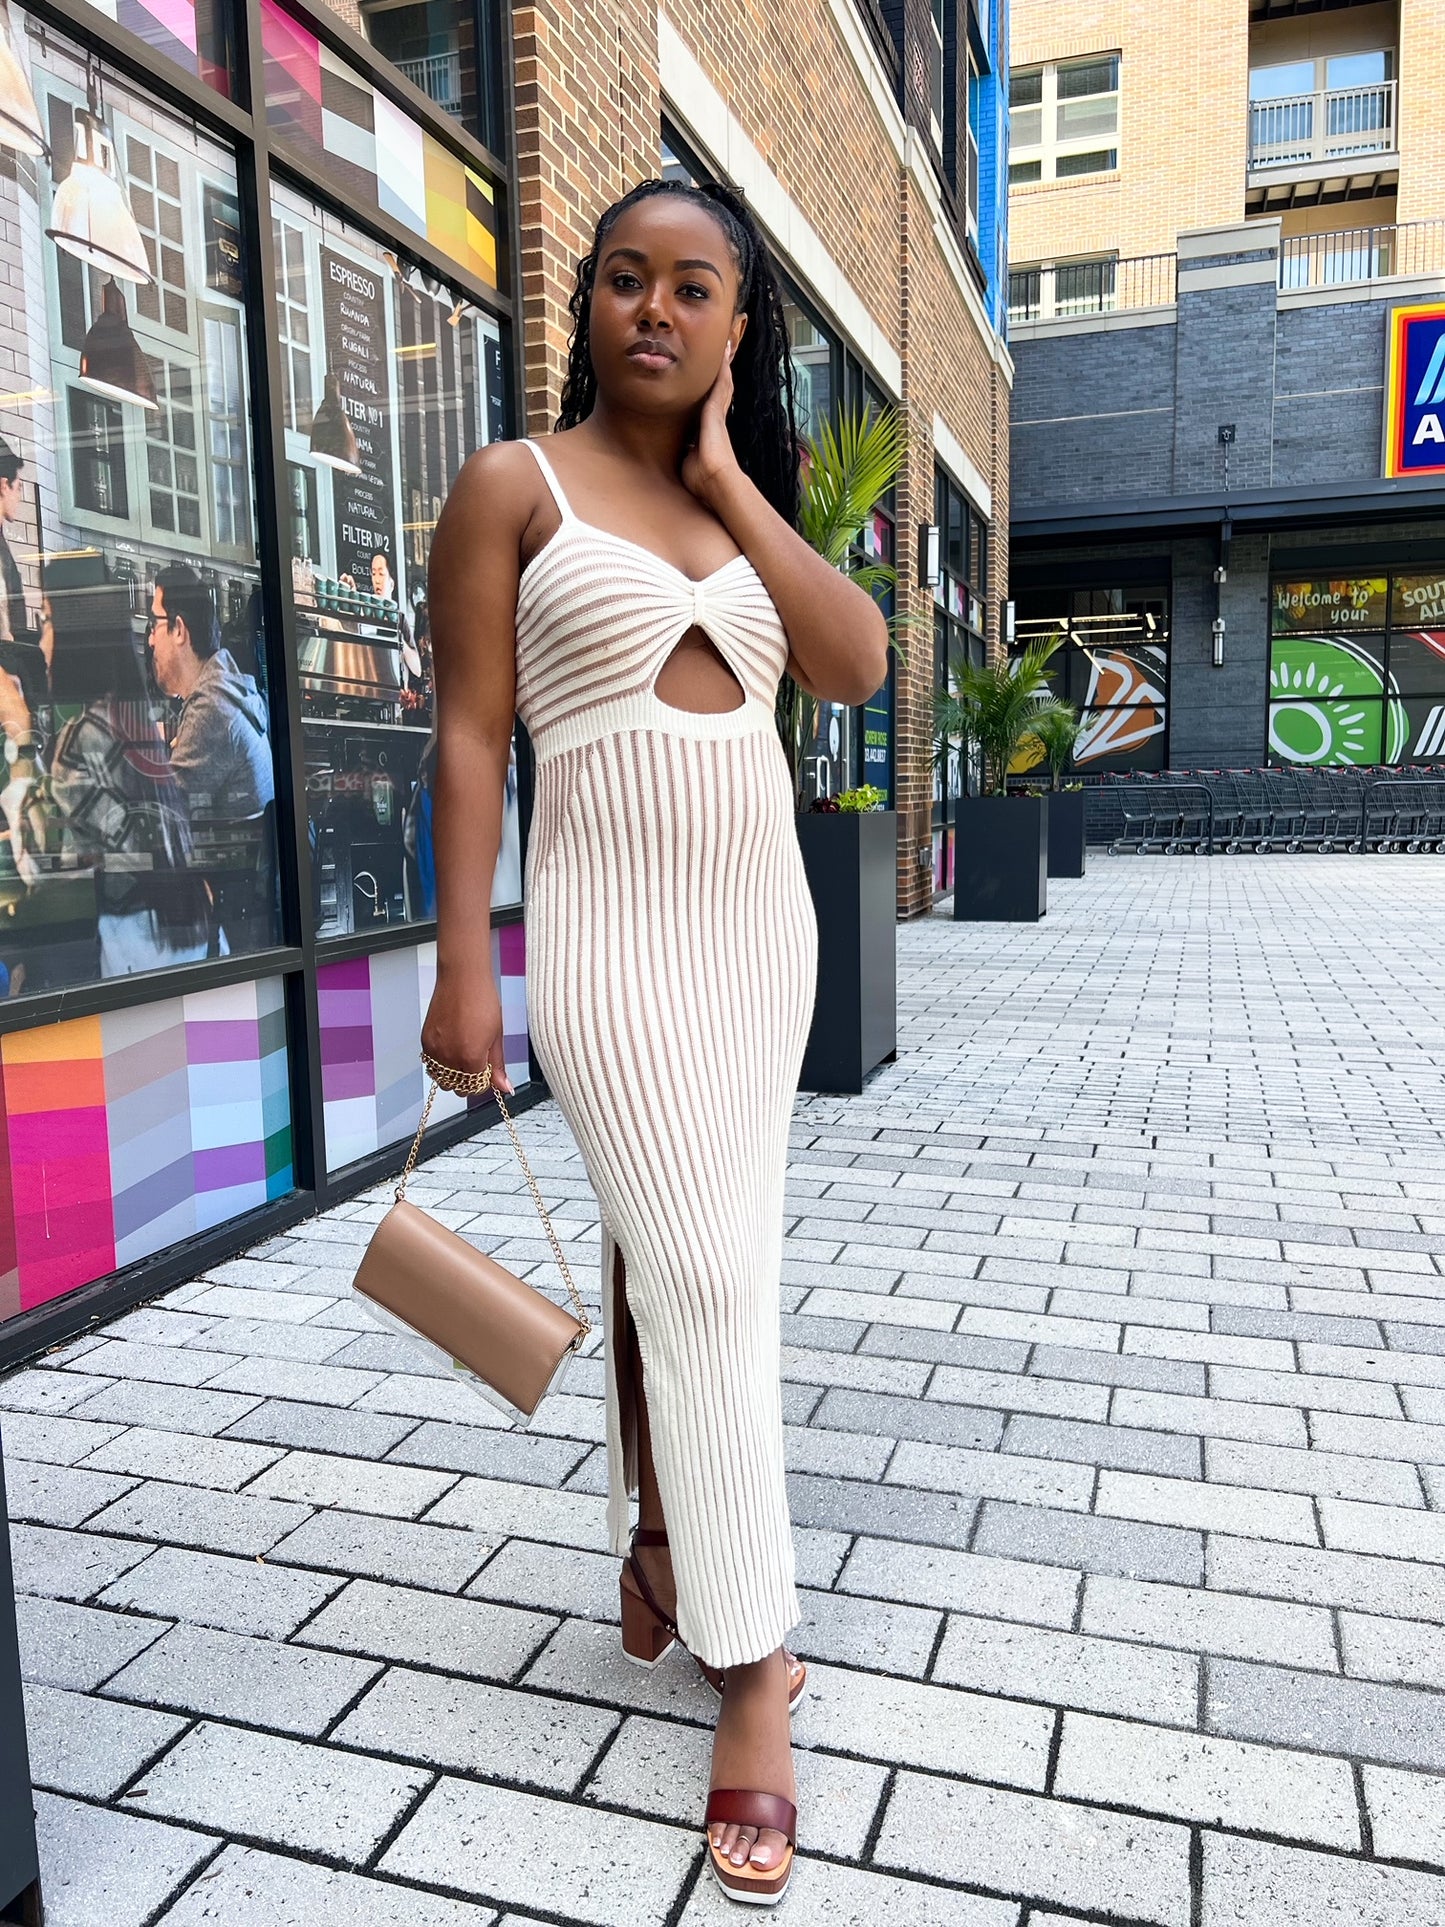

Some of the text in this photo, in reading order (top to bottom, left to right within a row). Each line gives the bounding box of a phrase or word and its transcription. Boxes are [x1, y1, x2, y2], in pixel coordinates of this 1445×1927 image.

[330, 261, 375, 300] ESPRESSO
[340, 302, 370, 327] RWANDA
[342, 336, 369, 359] RUGALI
[343, 371, 378, 395] NATURAL
[348, 501, 378, 520] NATURAL
[342, 523, 373, 548] FILTER
[384, 535, 390, 553] 2
[1278, 584, 1369, 610] Welcome to
[1330, 608, 1369, 625] your
